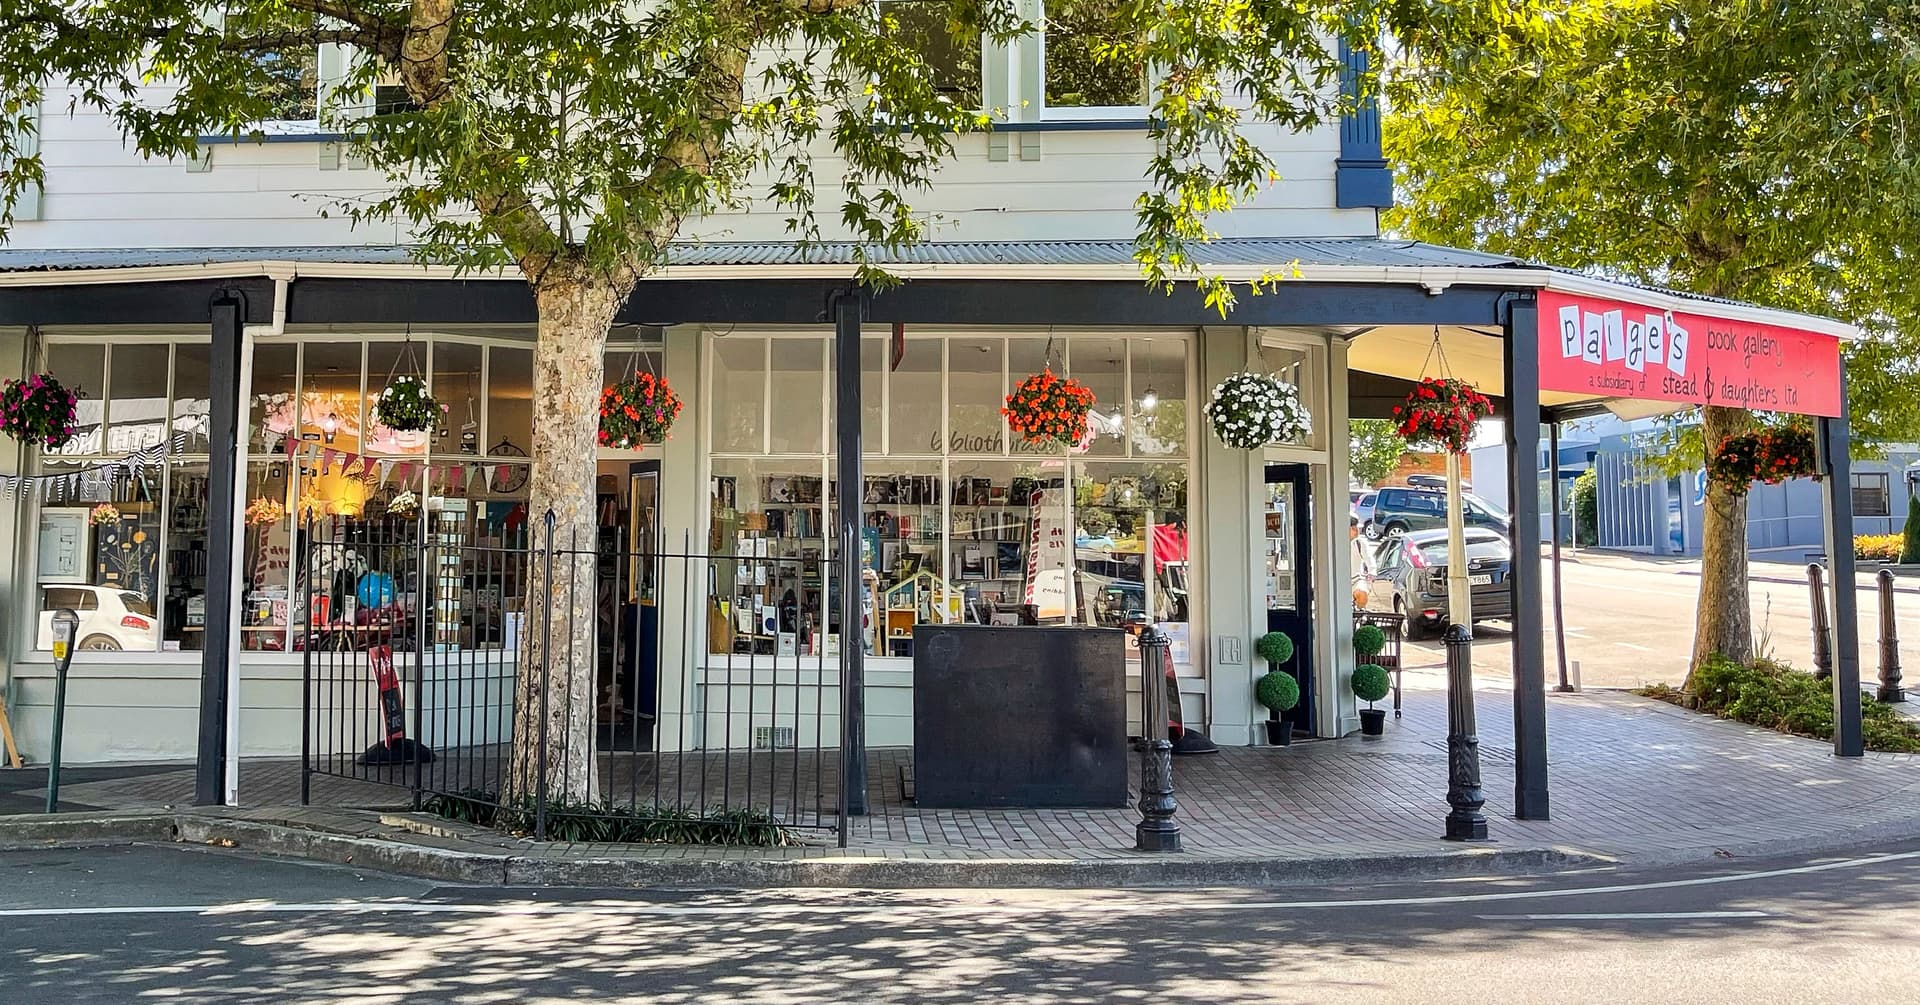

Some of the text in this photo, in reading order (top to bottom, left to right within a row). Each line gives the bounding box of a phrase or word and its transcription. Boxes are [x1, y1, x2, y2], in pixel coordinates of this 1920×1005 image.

[1564, 313, 1683, 366] paige's
[1707, 325, 1782, 369] book gallery
[1589, 371, 1648, 395] a subsidiary of
[1662, 366, 1799, 409] stead & daughters ltd
